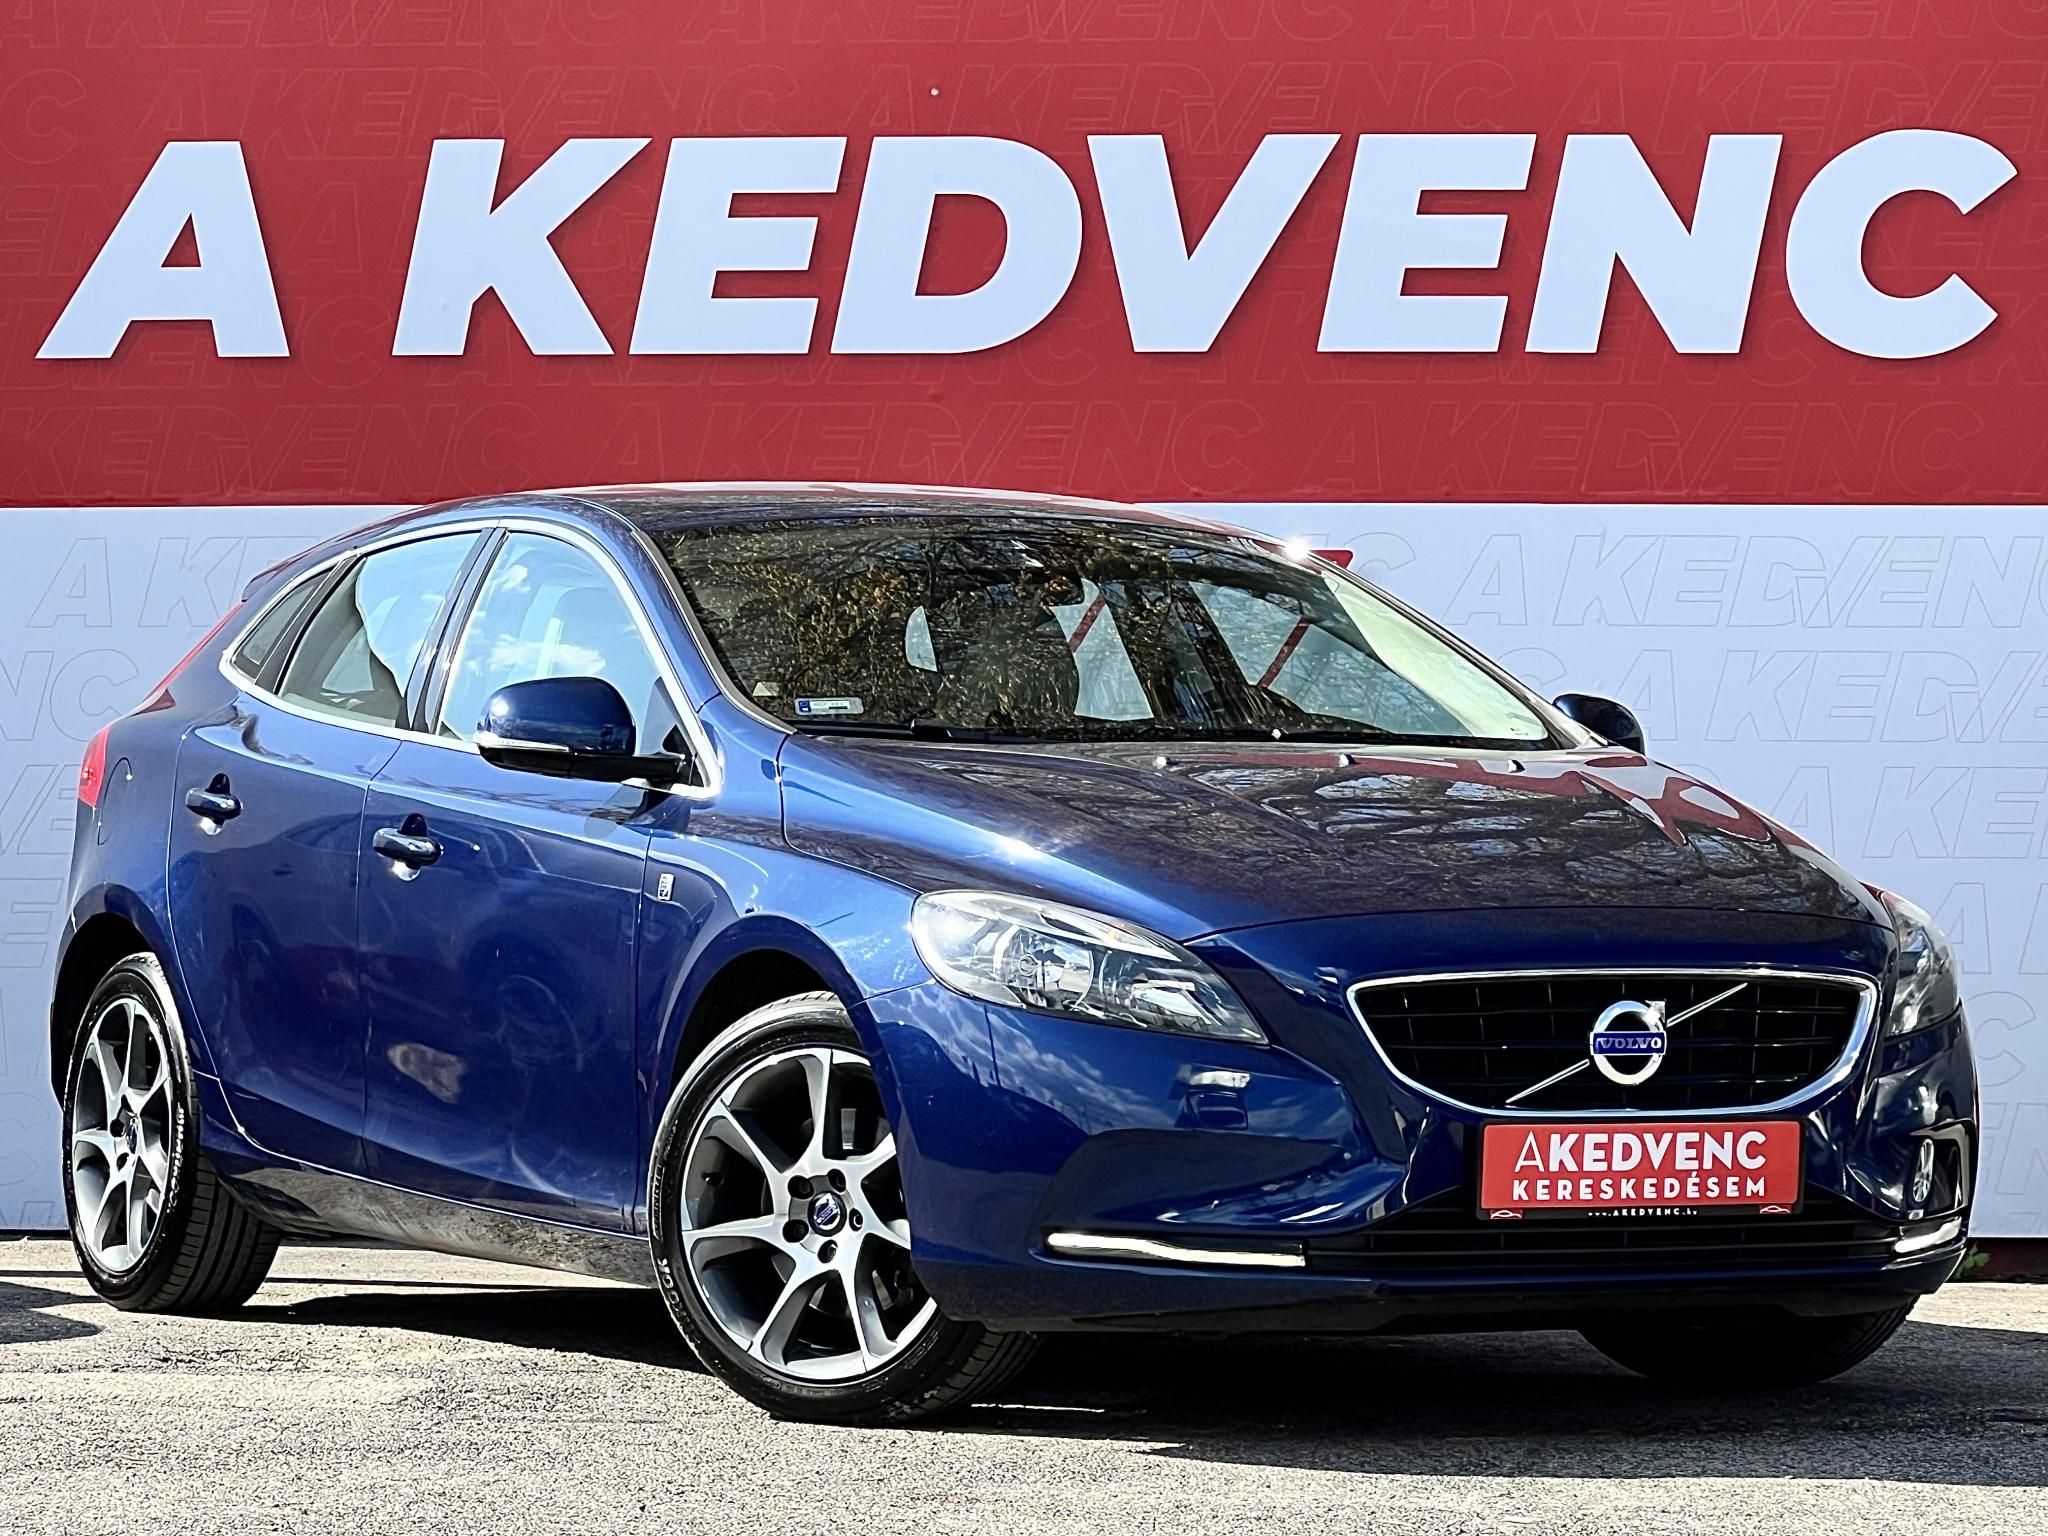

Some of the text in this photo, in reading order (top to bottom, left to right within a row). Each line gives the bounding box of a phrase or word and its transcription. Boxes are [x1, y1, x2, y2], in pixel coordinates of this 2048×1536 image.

[35, 140, 290, 359] A
[392, 129, 2018, 359] KEDVENC
[25, 537, 112, 628] A
[1441, 534, 1528, 626] A
[1552, 535, 2048, 628] KEDVEN
[1596, 1036, 1663, 1050] VOLVO
[1512, 1171, 1766, 1201] KERESKEDÉSEM
